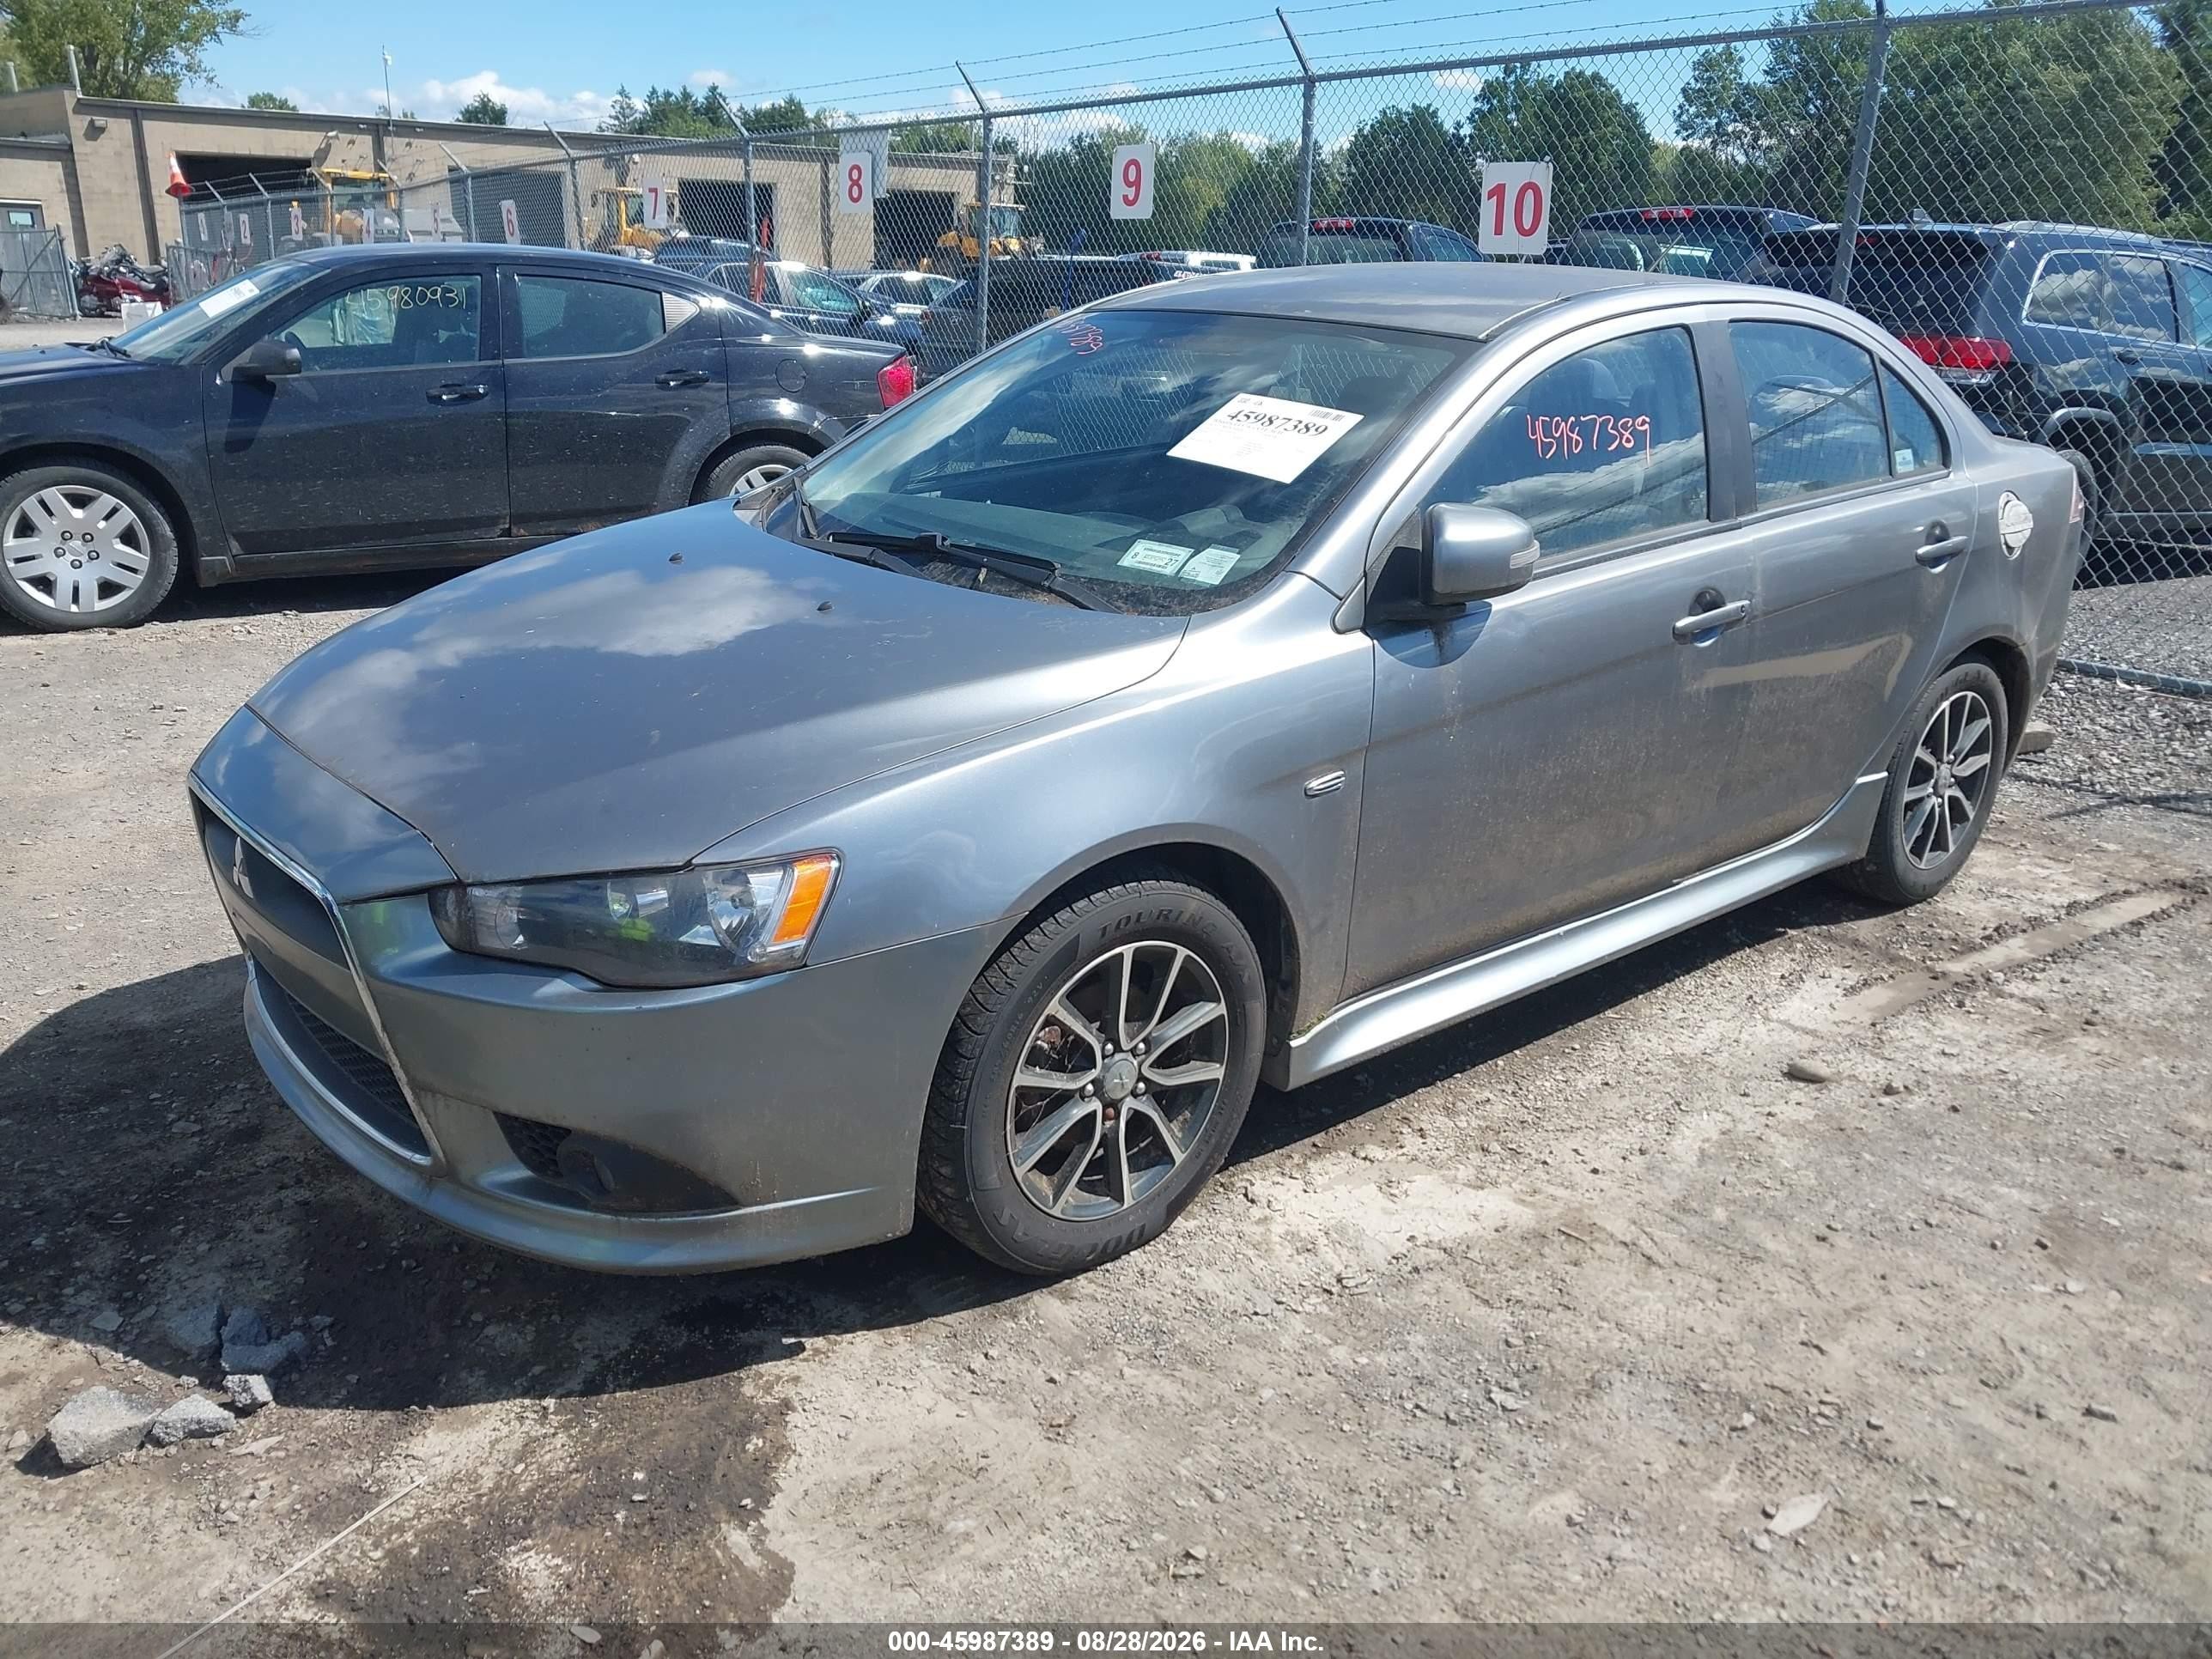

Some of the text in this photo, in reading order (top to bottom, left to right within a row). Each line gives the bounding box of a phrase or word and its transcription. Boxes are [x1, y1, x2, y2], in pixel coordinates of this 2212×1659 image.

[848, 163, 862, 204] 8
[1122, 159, 1141, 207] 9
[648, 187, 659, 220] 7
[1487, 181, 1543, 237] 10
[241, 219, 247, 239] 2
[294, 214, 300, 235] 3
[365, 216, 371, 239] 4
[433, 209, 440, 234] 5
[506, 208, 515, 237] 6
[345, 285, 466, 315] 45980931
[1227, 410, 1328, 436] 45987389
[1526, 414, 1650, 465] 45987389
[1165, 558, 1179, 567] 27
